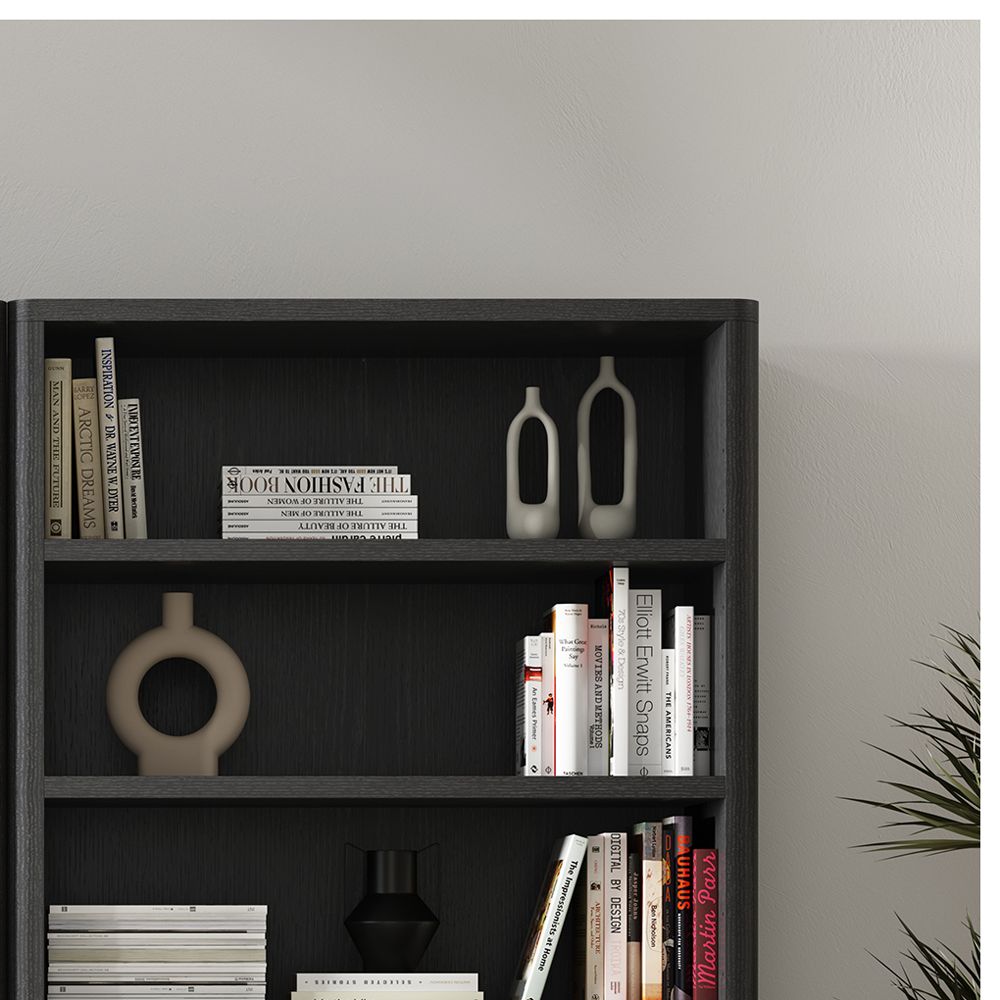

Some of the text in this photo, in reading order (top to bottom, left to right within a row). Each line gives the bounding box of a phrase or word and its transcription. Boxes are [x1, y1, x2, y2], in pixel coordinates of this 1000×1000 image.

[52, 381, 60, 408] MAN
[102, 349, 119, 513] INSPIRATION DR. WAYNE DYER
[53, 438, 61, 460] THE
[53, 463, 62, 508] FUTURE
[78, 407, 96, 529] ARCTIC DREAMS
[227, 476, 408, 493] THE FASHION BOOK
[297, 522, 407, 530] THE ALLURE OF BEAUTY
[594, 645, 603, 749] MOVIES AND METHODS
[634, 594, 653, 756] Elliott Erwitt Snaps
[538, 860, 578, 972] The Impressionists at Home
[610, 832, 621, 934] DIGITAL BY DESIGN
[677, 835, 691, 911] BAUHAUS
[697, 852, 716, 988] Martin Parr
